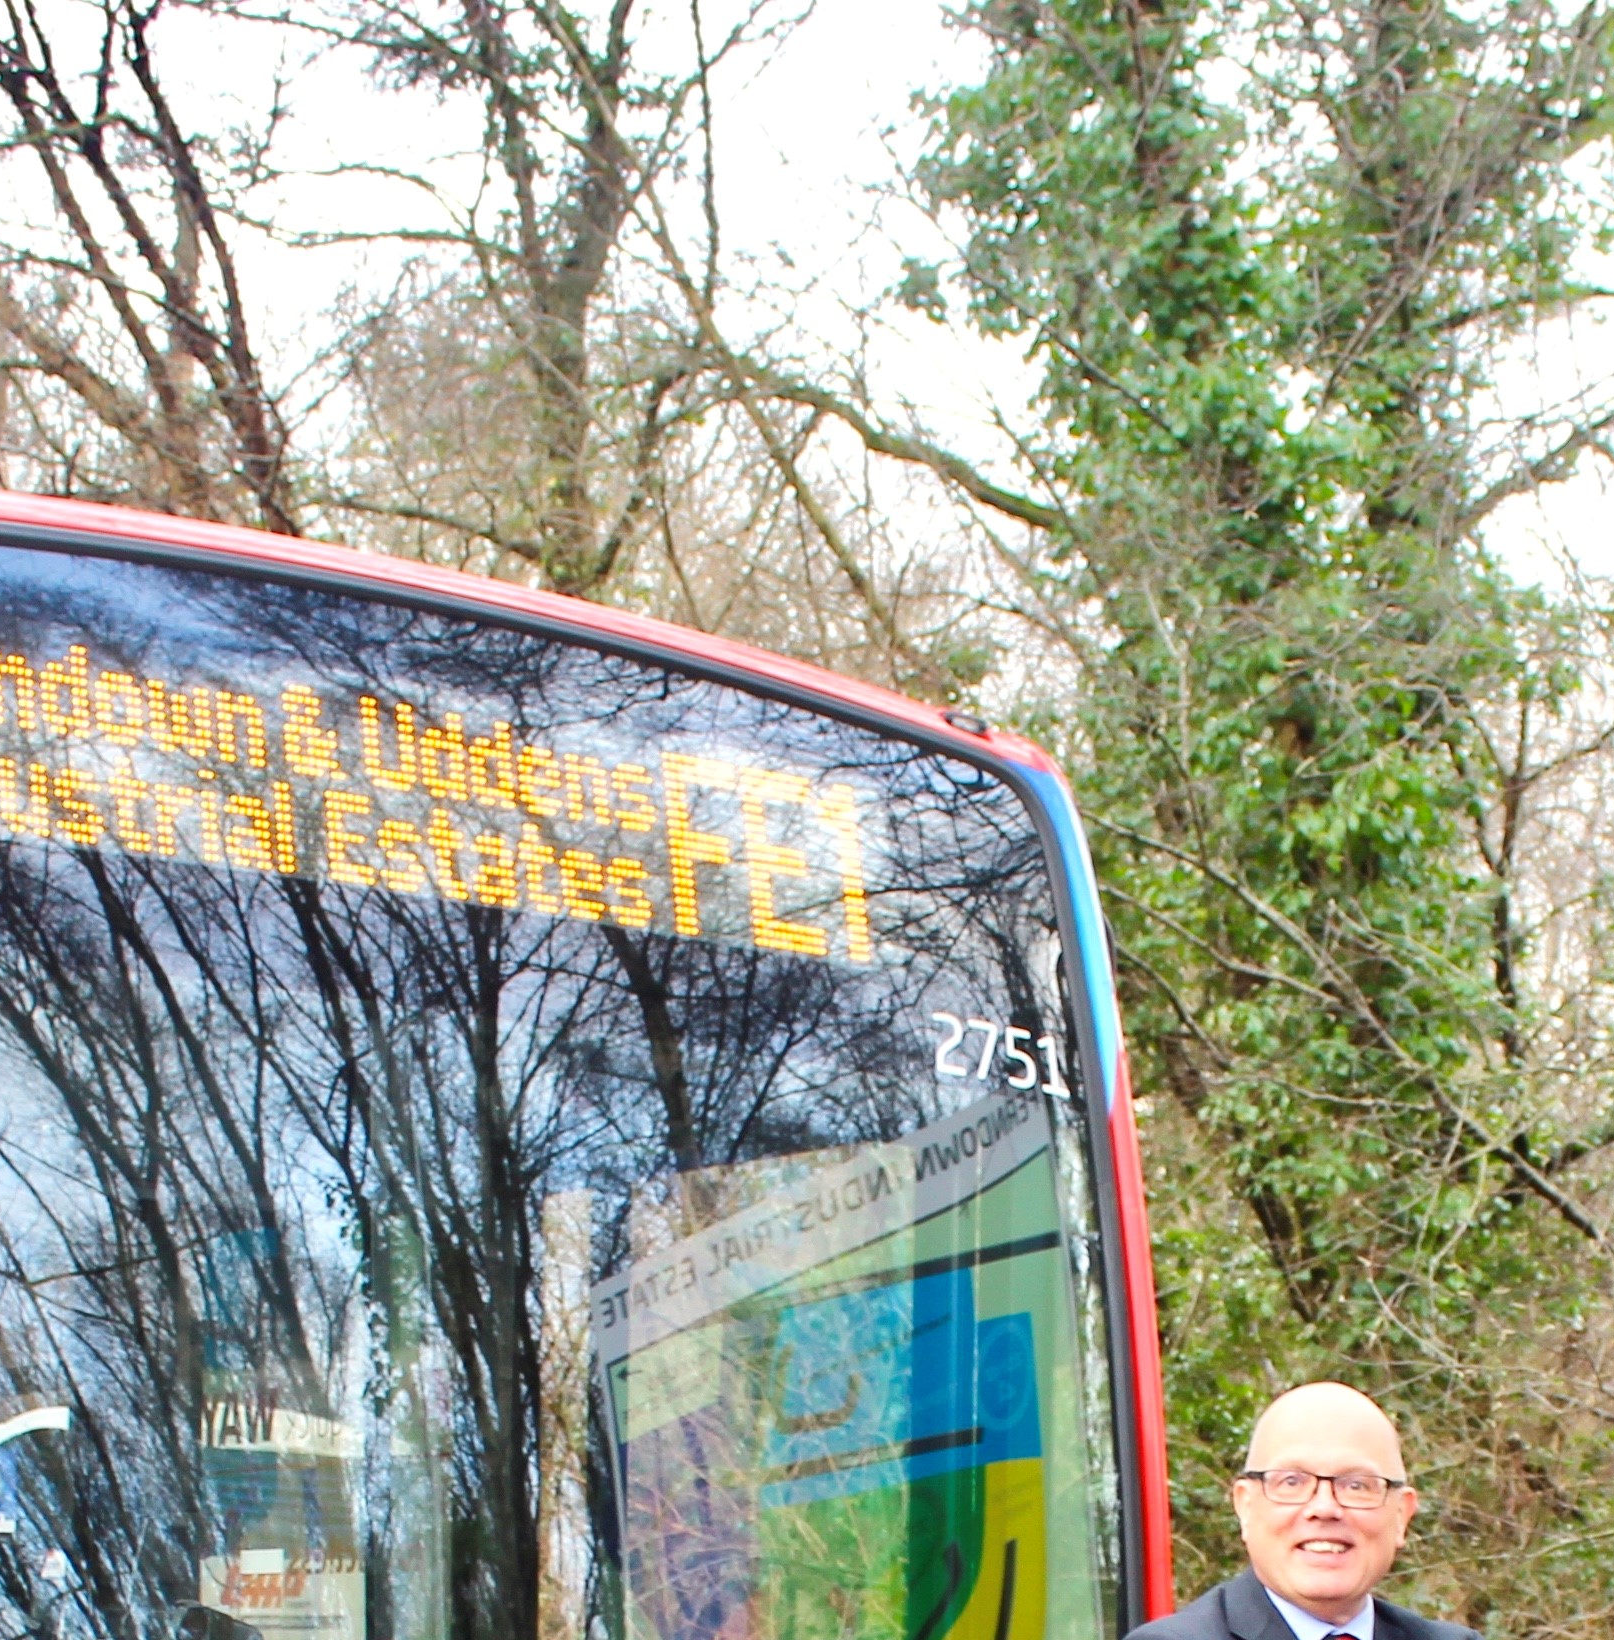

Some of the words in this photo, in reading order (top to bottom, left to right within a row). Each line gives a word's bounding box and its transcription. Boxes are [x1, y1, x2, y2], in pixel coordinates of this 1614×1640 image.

[284, 683, 346, 780] &
[359, 695, 657, 832] Uddens
[324, 789, 653, 928] Estates
[661, 750, 872, 962] FE1
[932, 1012, 1071, 1099] 2751
